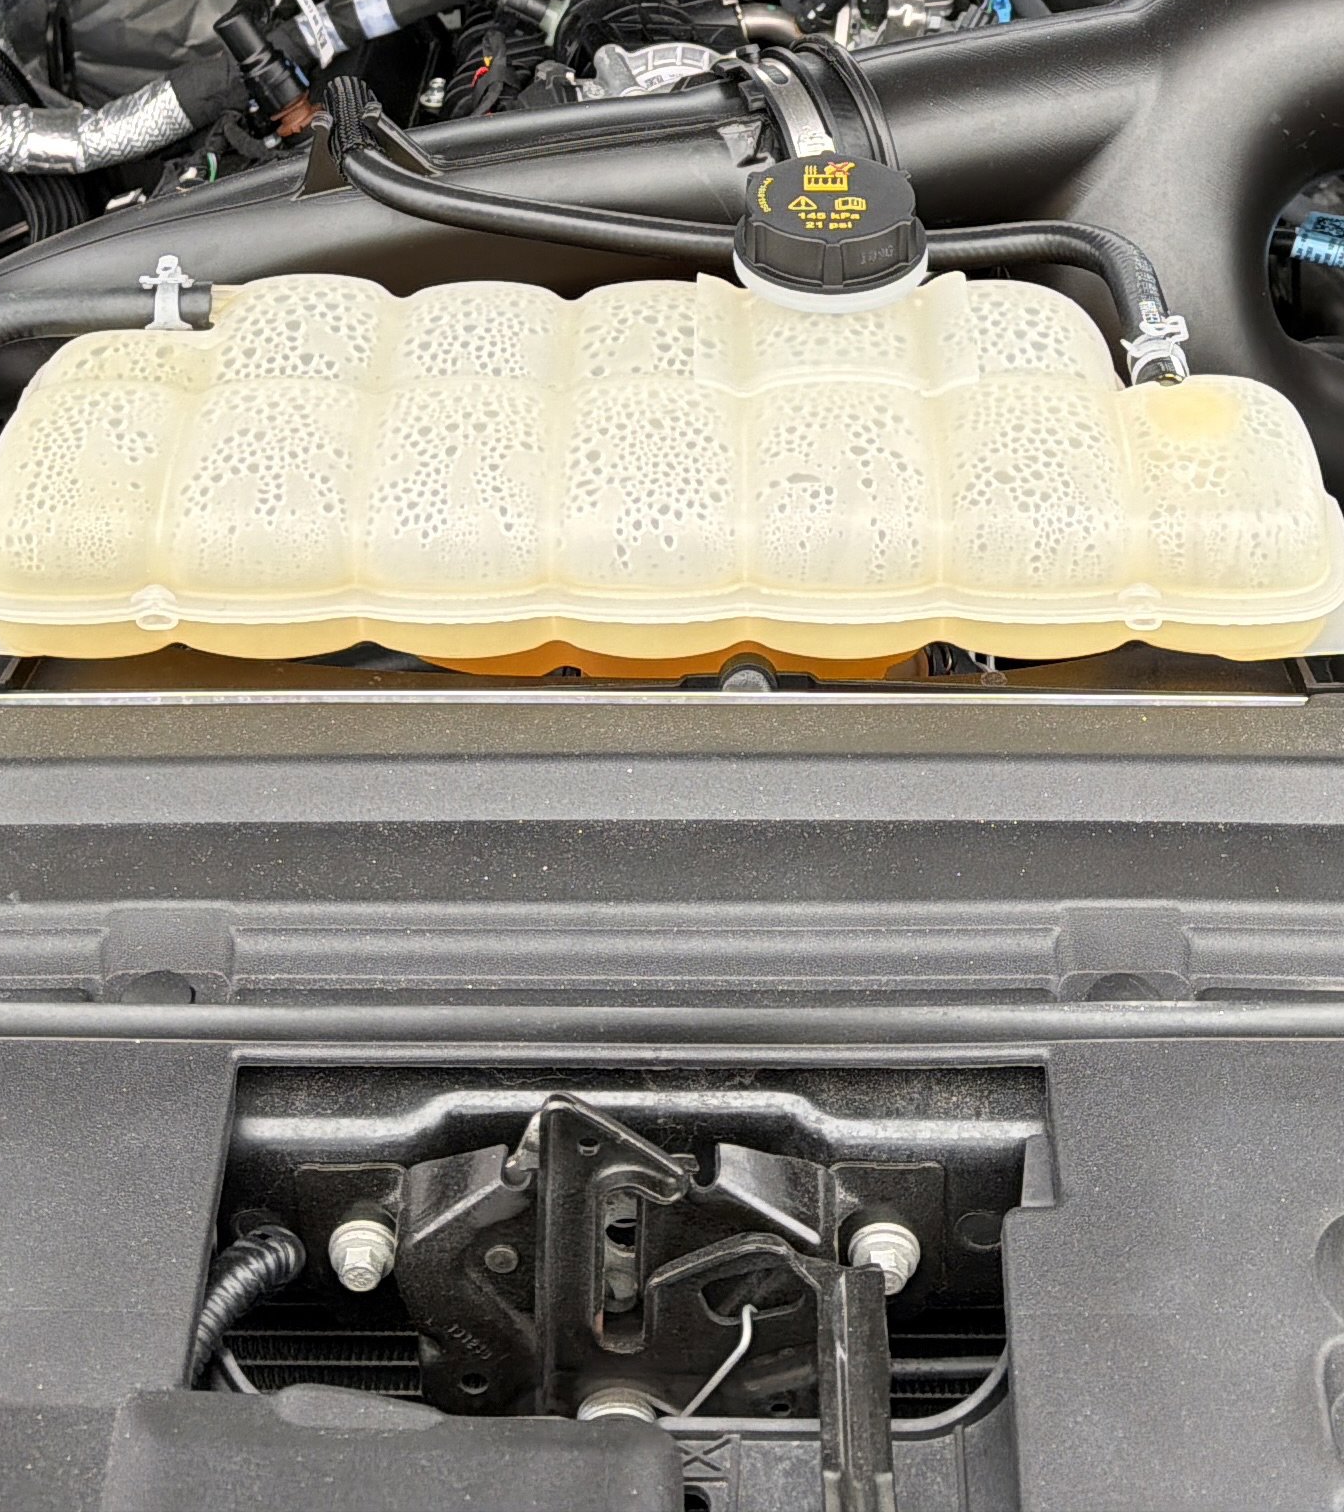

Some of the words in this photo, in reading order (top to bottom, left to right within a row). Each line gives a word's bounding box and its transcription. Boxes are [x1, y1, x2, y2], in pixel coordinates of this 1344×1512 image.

[831, 212, 860, 220] kPa
[805, 221, 825, 229] 21
[829, 221, 853, 230] psi
